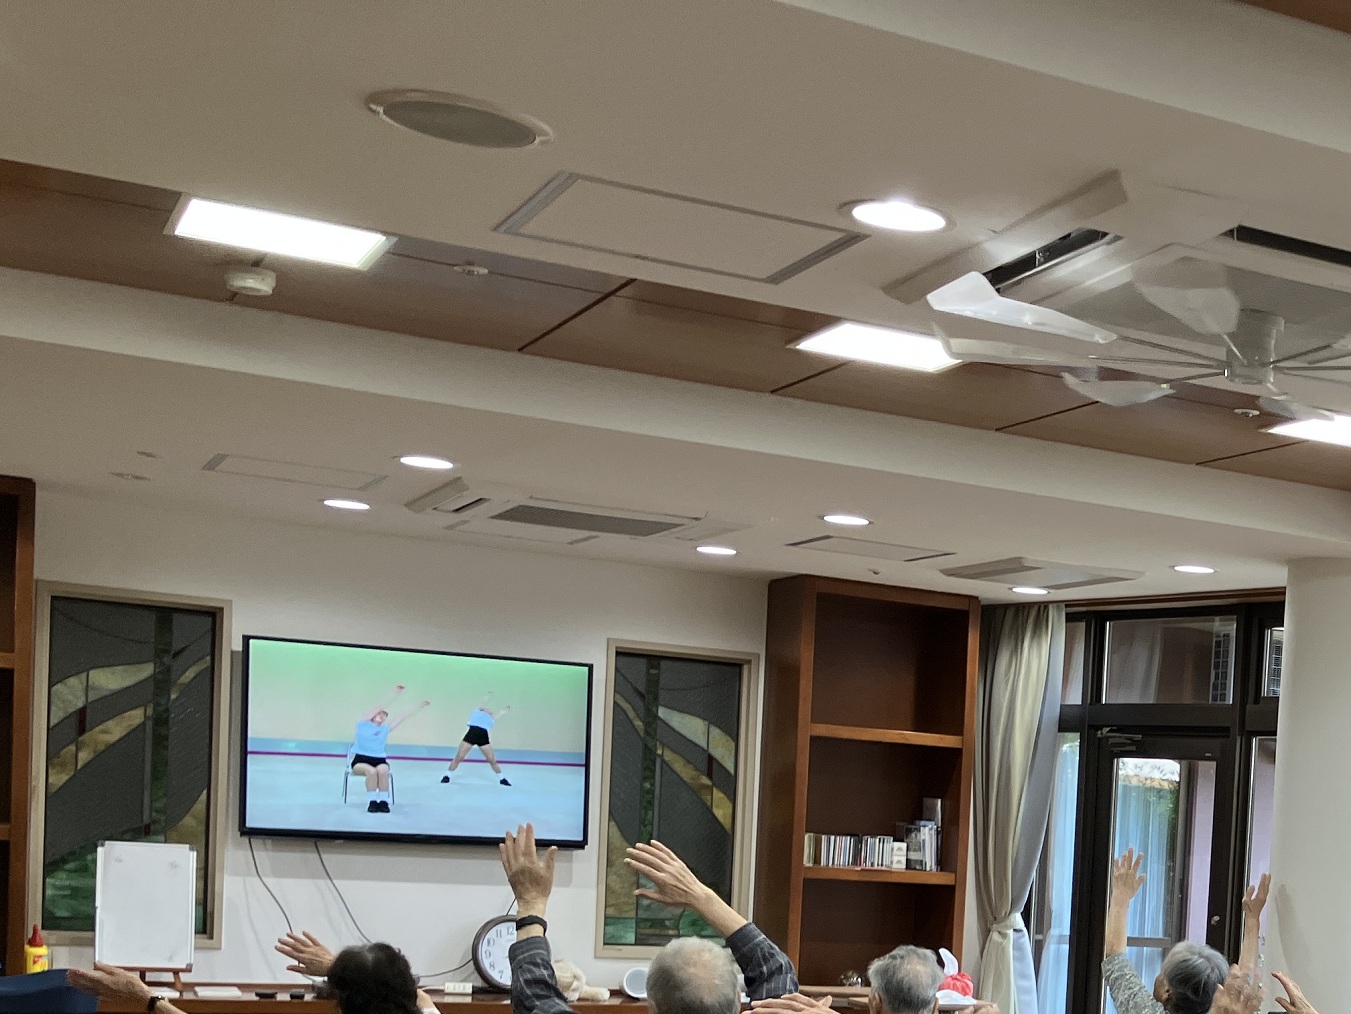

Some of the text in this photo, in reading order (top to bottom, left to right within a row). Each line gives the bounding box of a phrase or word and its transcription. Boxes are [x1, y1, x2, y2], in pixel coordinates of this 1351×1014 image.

[495, 928, 502, 938] 11
[506, 924, 515, 936] 12
[486, 937, 496, 947] 10
[484, 949, 492, 959] 9
[489, 961, 496, 971] 8
[498, 970, 504, 980] 7
